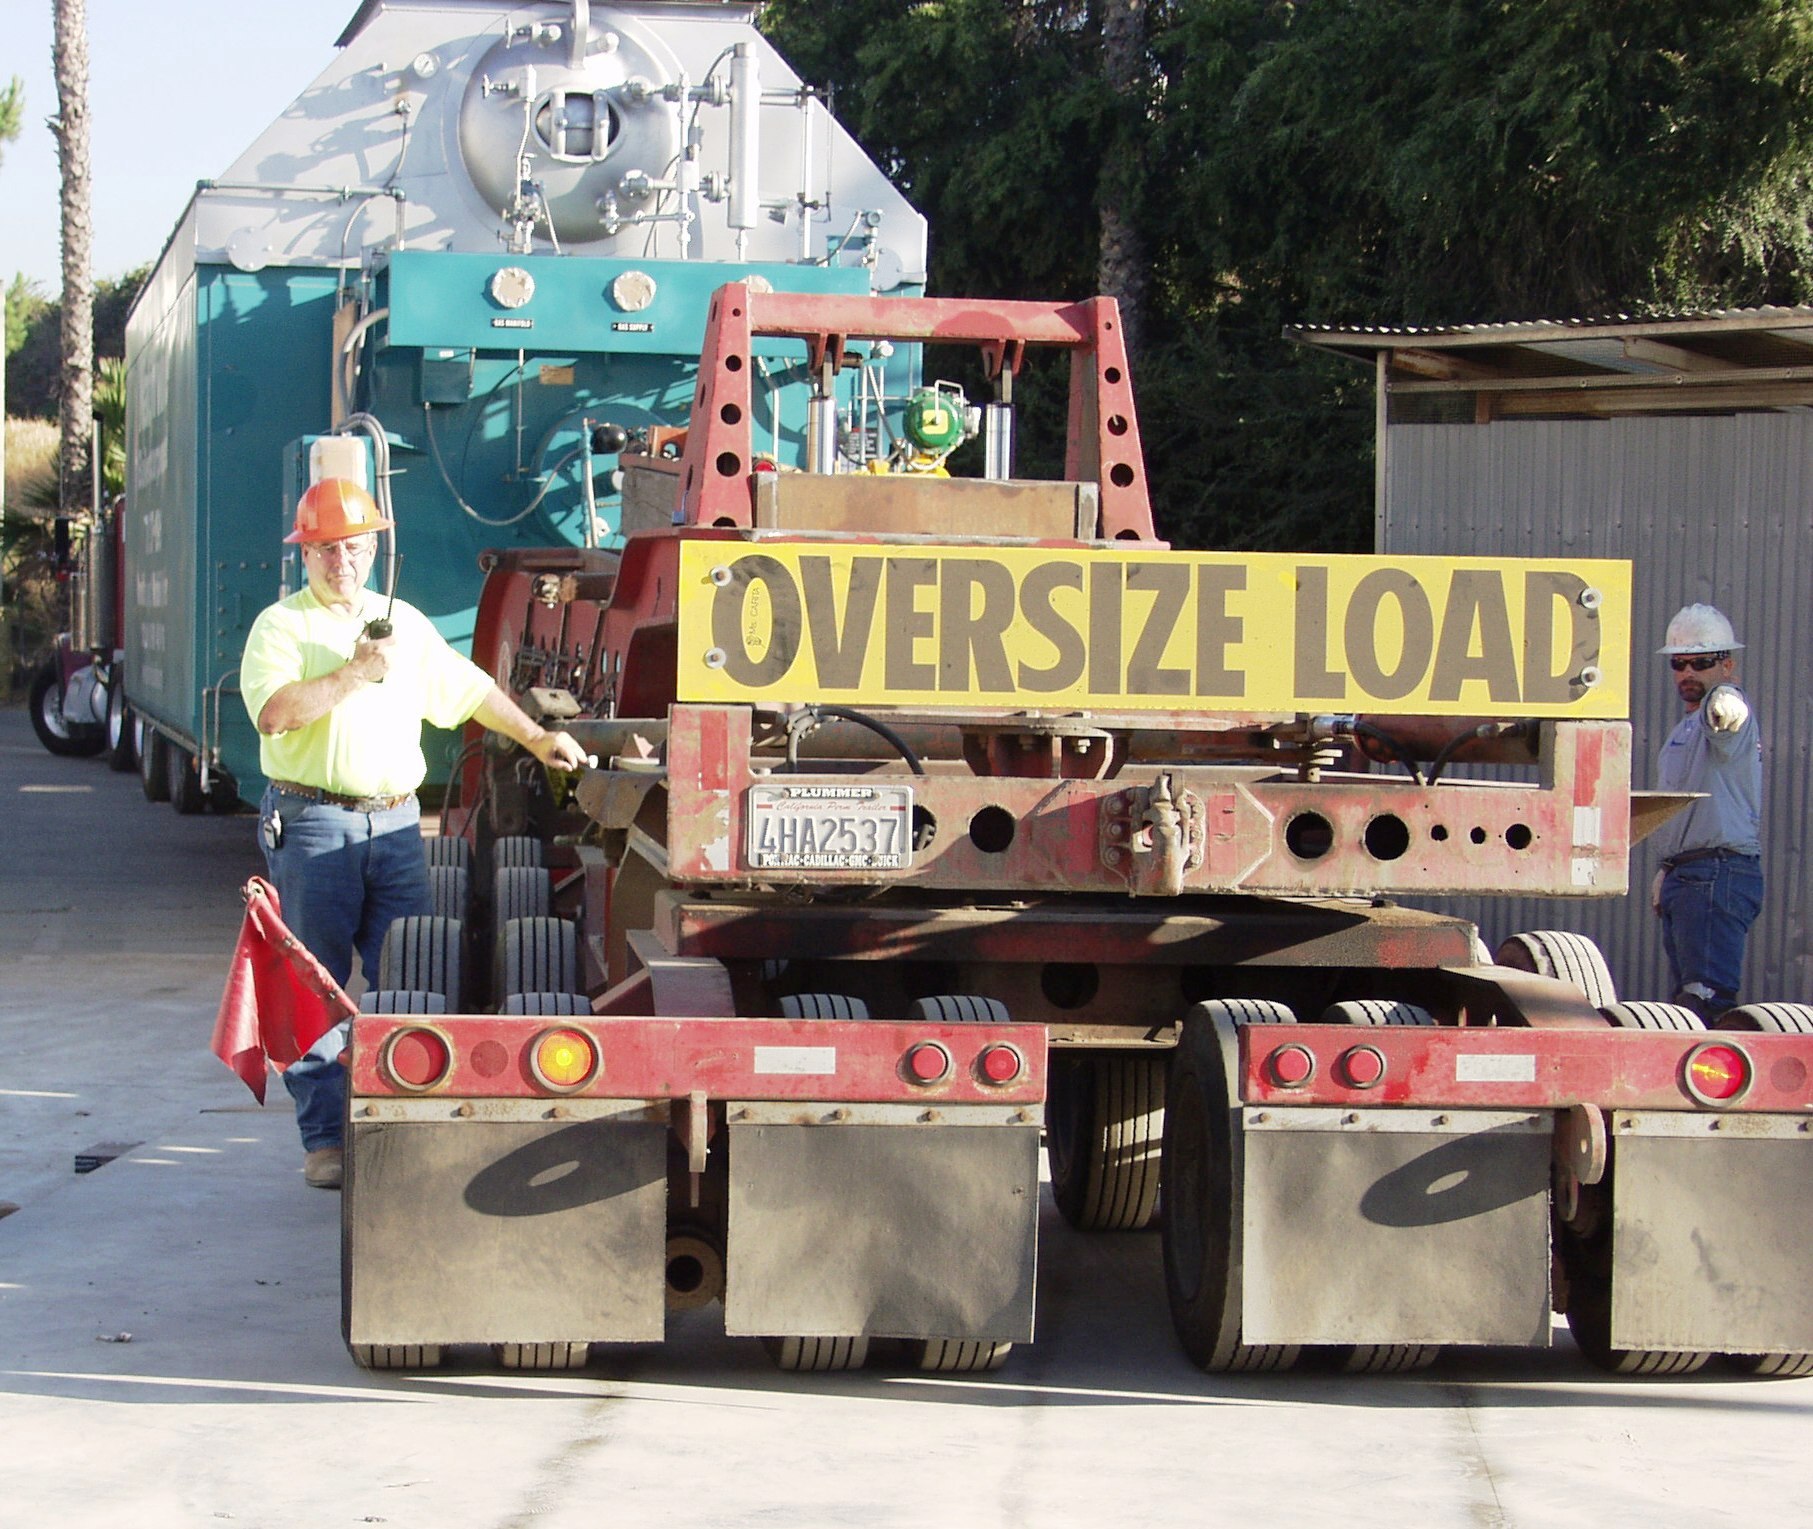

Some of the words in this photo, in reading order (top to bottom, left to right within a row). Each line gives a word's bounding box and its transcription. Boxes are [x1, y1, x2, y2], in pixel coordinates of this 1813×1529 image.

[617, 323, 628, 331] GAS
[629, 323, 648, 332] SUPPLY
[710, 553, 1248, 697] OVERSIZE
[1293, 565, 1602, 704] LOAD
[789, 787, 873, 799] PLUMMER
[776, 800, 822, 812] California
[827, 801, 851, 811] Perm
[857, 800, 887, 811] Trailer
[759, 816, 899, 853] 4HA2537
